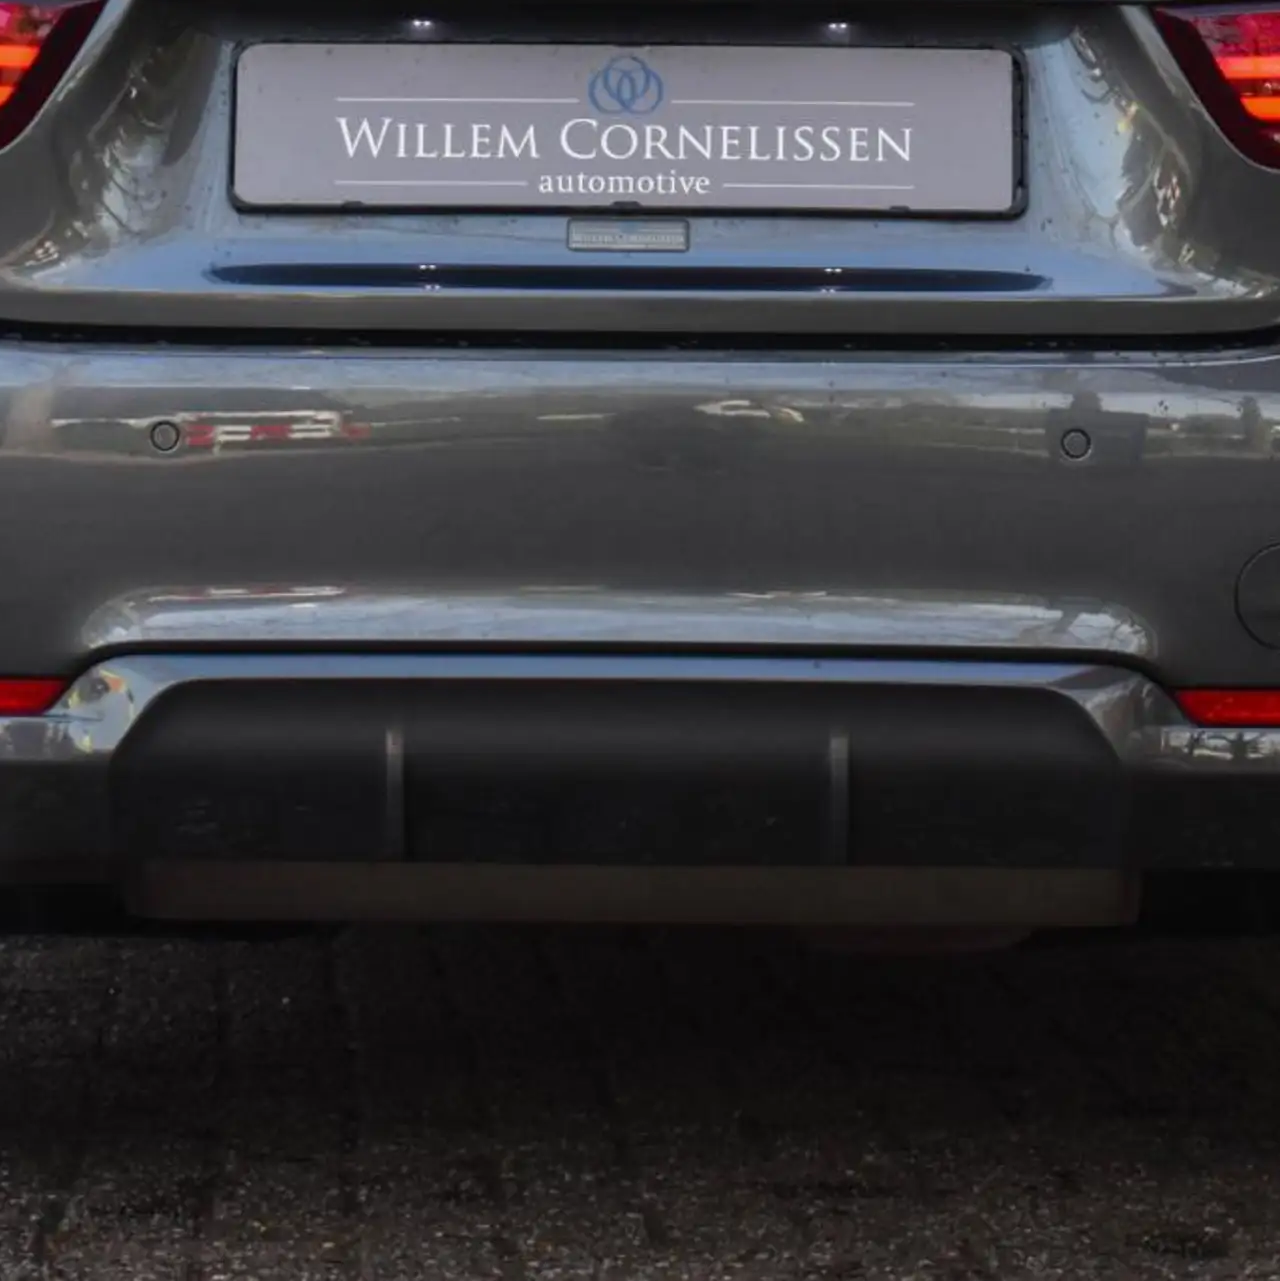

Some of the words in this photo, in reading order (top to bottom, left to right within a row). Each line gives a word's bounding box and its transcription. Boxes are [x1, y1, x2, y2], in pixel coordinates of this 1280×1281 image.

[336, 117, 540, 159] WILLEM
[560, 118, 912, 162] CORNELISSEN
[539, 169, 710, 195] automotive
